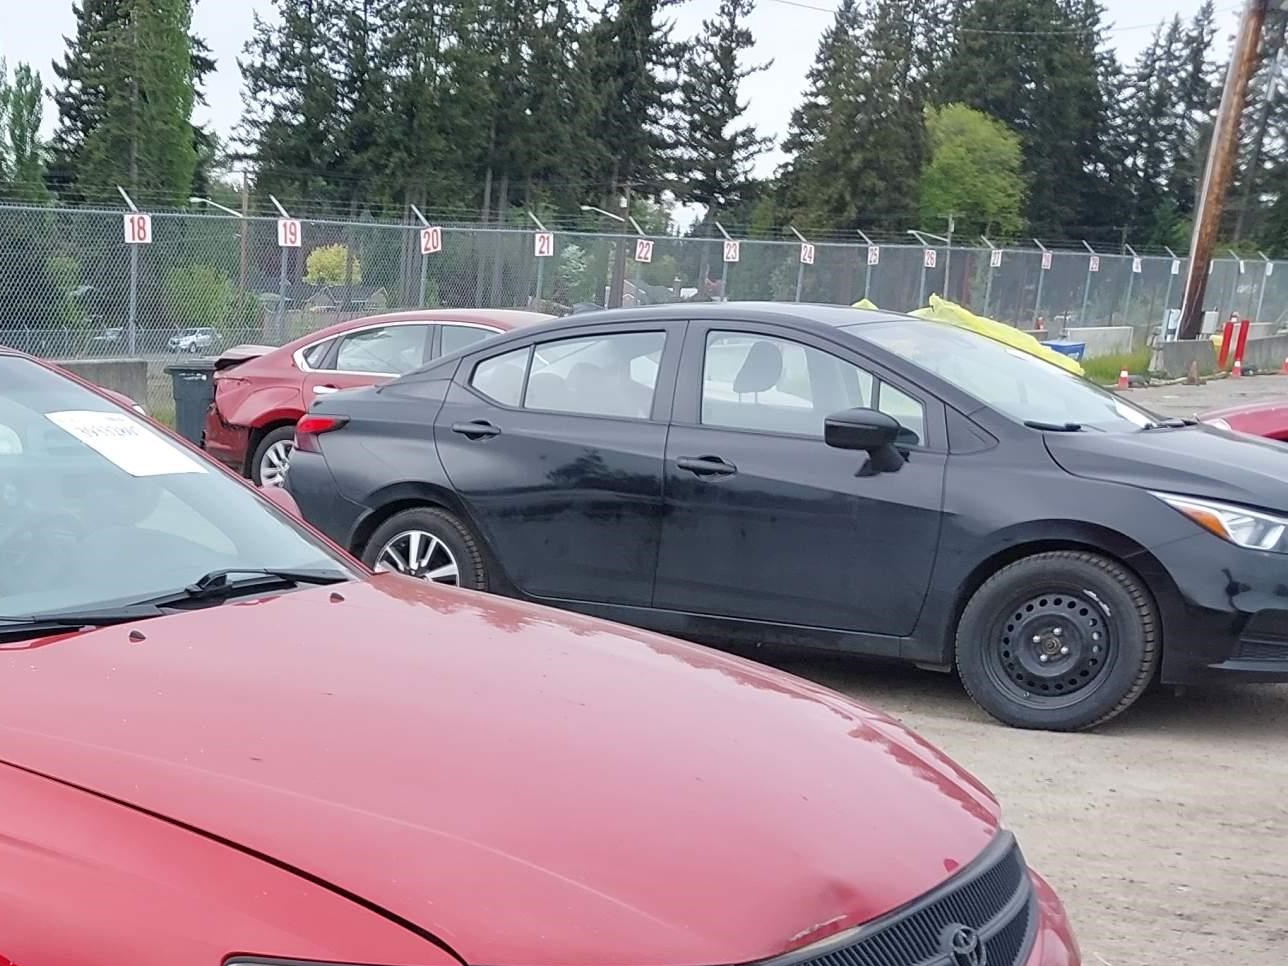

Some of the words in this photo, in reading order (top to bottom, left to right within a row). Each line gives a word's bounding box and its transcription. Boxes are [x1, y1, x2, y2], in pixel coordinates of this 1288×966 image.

[130, 216, 146, 241] 18
[282, 222, 297, 244] 19
[423, 229, 439, 252] 20
[538, 235, 551, 254] 21
[637, 242, 651, 260] 22
[725, 243, 737, 260] 23
[802, 245, 813, 262] 24
